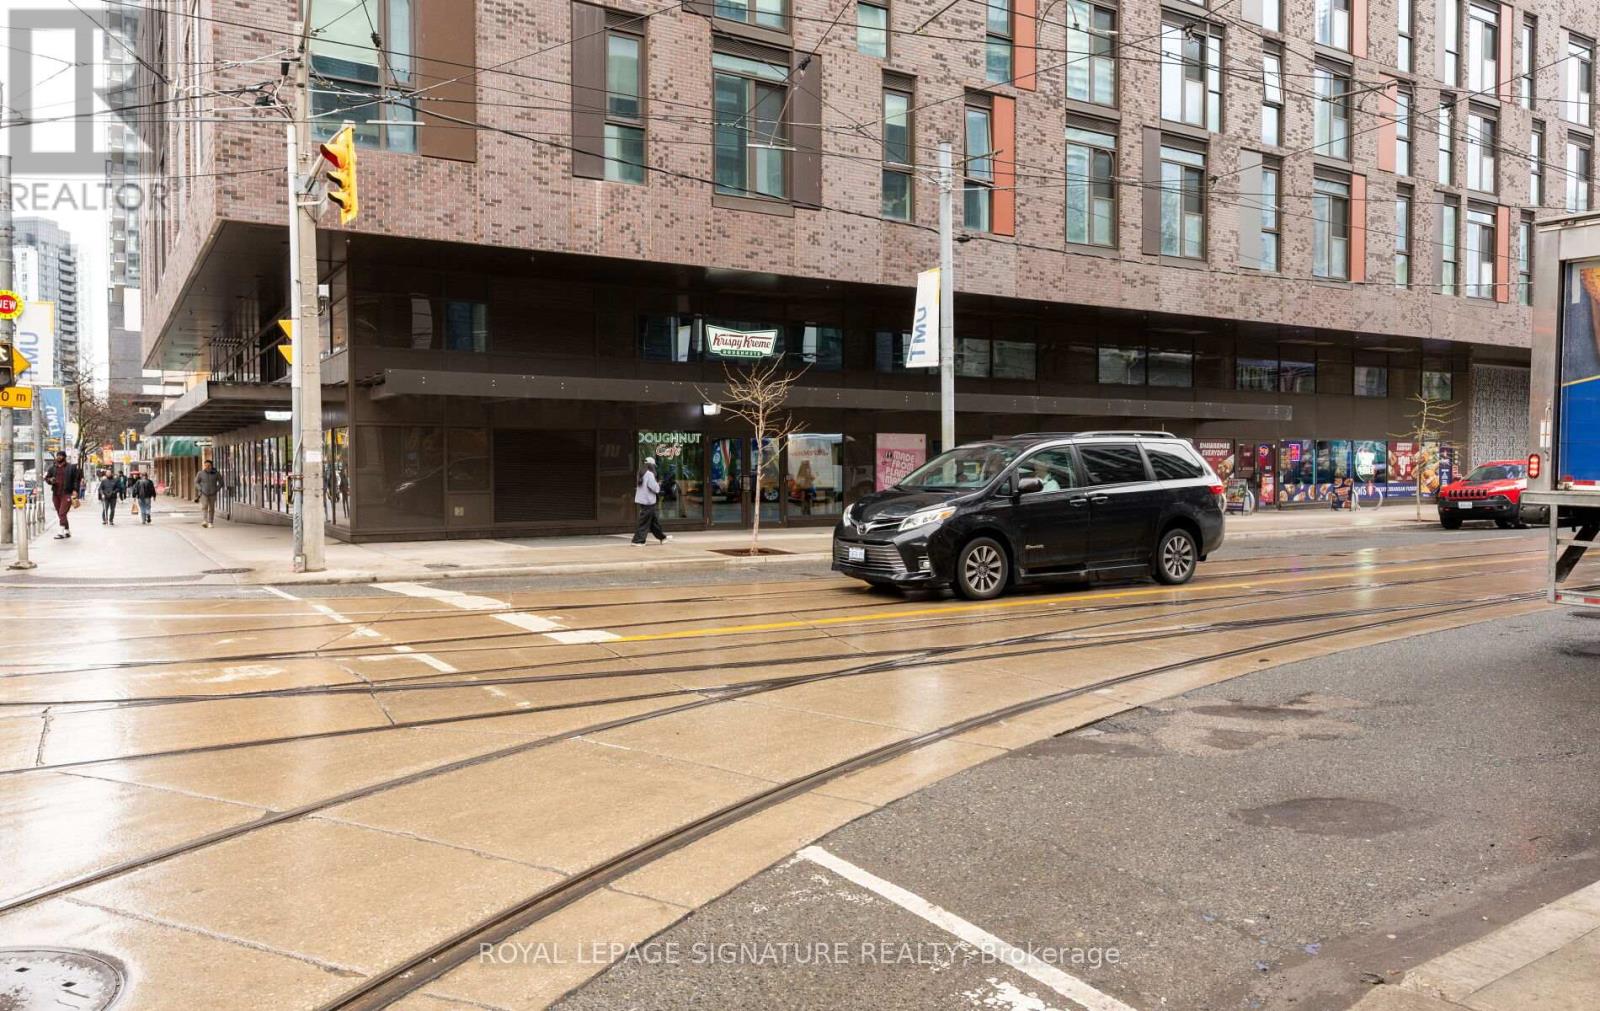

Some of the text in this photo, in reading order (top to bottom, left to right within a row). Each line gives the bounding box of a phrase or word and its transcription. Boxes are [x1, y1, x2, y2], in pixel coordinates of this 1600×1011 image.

[908, 306, 927, 361] TMU
[713, 333, 772, 349] Krispy Kreme
[16, 393, 26, 401] m
[638, 432, 702, 444] DOUGHNUT
[893, 451, 916, 463] MADE
[891, 459, 914, 472] FROM
